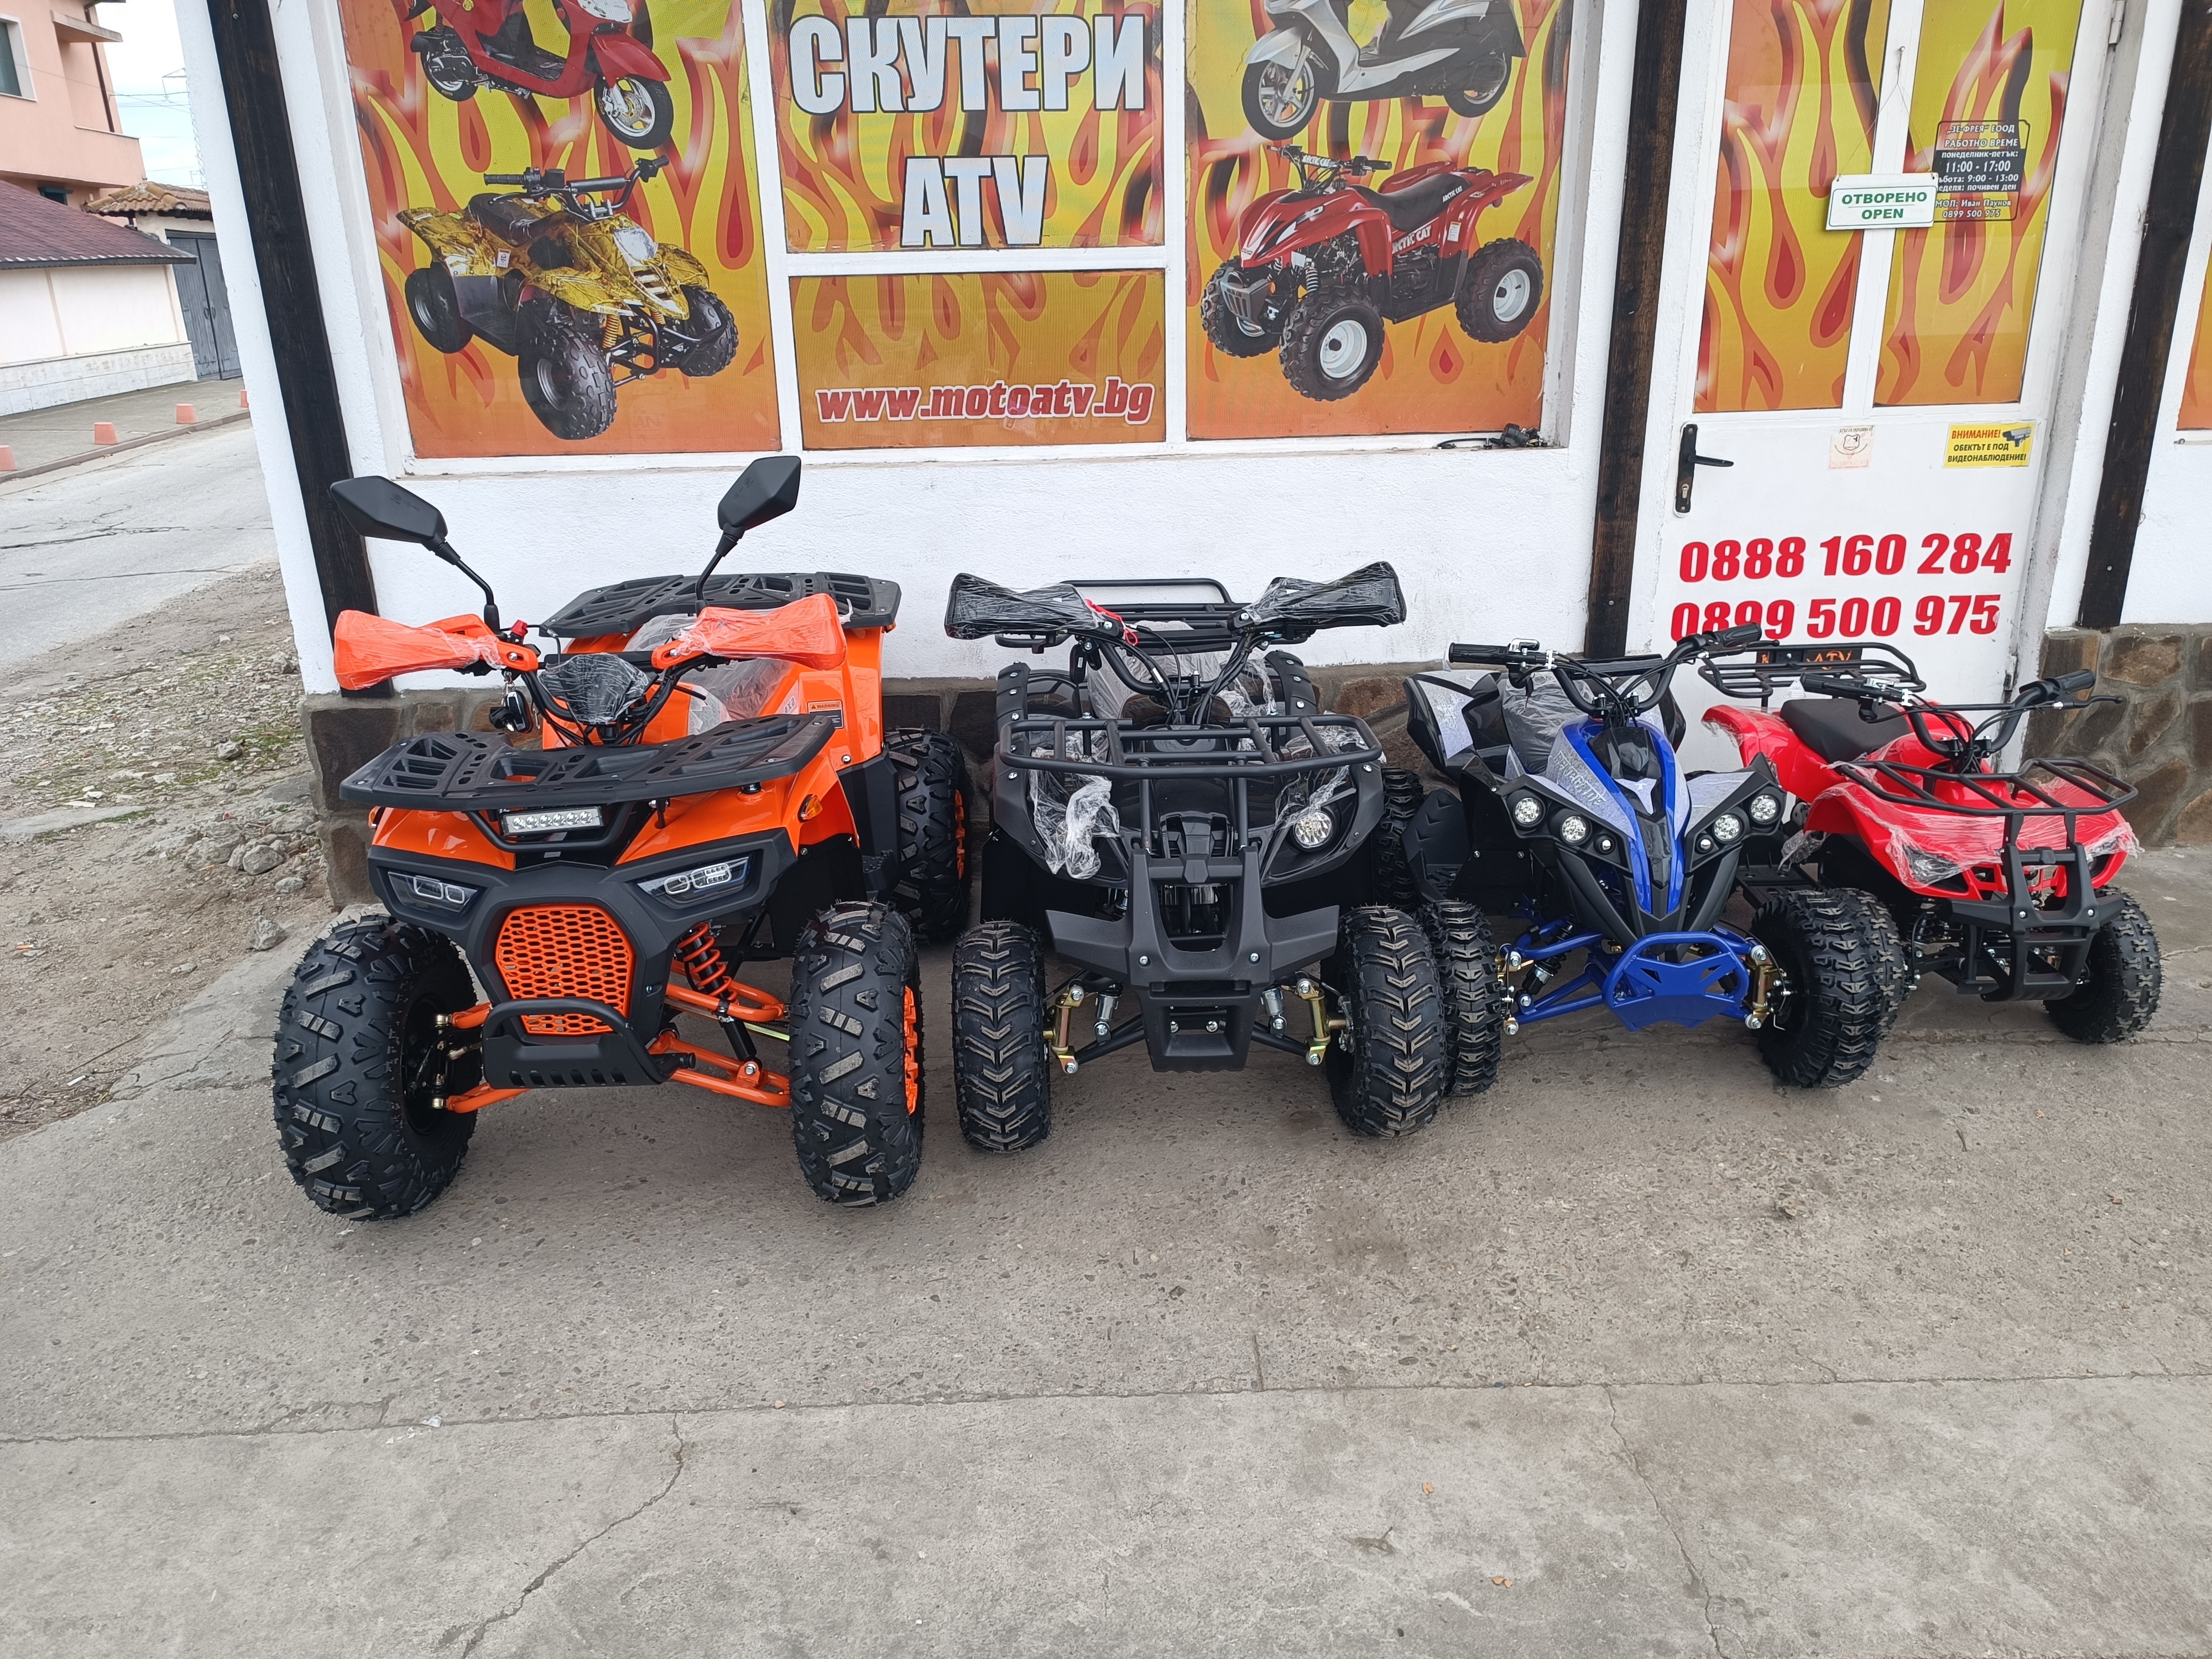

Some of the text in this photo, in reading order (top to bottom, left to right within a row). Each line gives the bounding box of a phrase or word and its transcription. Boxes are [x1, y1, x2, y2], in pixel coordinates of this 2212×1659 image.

[789, 15, 1145, 113] СКУТЕРИ
[1991, 124, 2015, 133] ЕООД
[1944, 138, 2018, 148] РАБОТНО ВРЕМЕ
[1942, 151, 2018, 159] понеделник-петък:
[1946, 160, 1973, 173] 11:00
[1984, 160, 2011, 173] 17:00
[1996, 174, 2018, 182] 13:00
[900, 155, 1049, 247] ATV
[1841, 192, 1927, 205] ОТВОРЕНО
[1984, 200, 2011, 208] Паунов
[1861, 208, 1903, 220] OPEN
[1392, 233, 1415, 254] RCTIC
[1416, 225, 1431, 242] CAT
[815, 376, 1154, 424] www.motoatv.bg
[1952, 430, 2001, 439] ВНИМАНИЕ!
[1948, 453, 2026, 463] ВИДЕОНАБЛЮДЕНИЕ!
[1679, 533, 2013, 583] 0888 160 284
[1671, 594, 2001, 642] 0899 500 975
